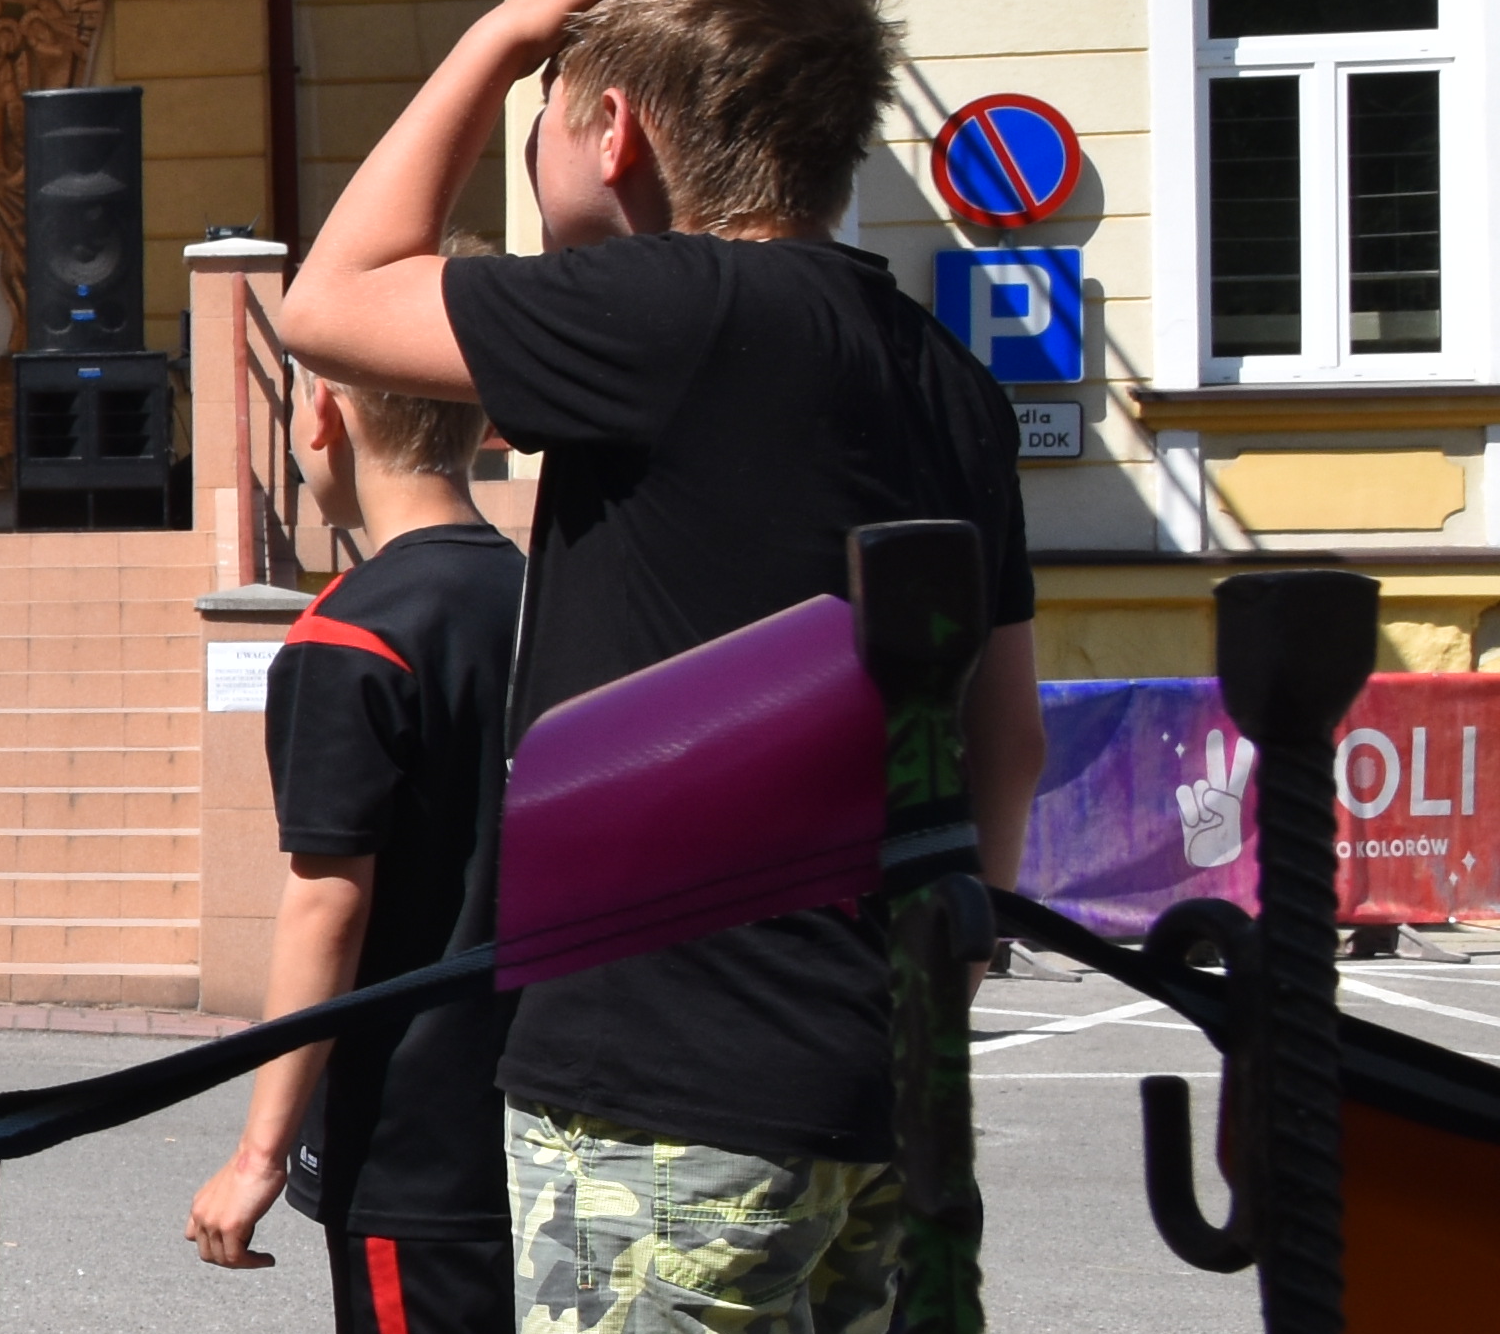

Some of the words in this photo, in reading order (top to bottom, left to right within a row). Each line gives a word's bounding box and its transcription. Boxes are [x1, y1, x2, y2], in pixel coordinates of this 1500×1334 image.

[970, 264, 1050, 366] P
[1019, 409, 1051, 424] dla
[1029, 432, 1069, 448] DDK
[1356, 834, 1448, 858] KOLORÓW
